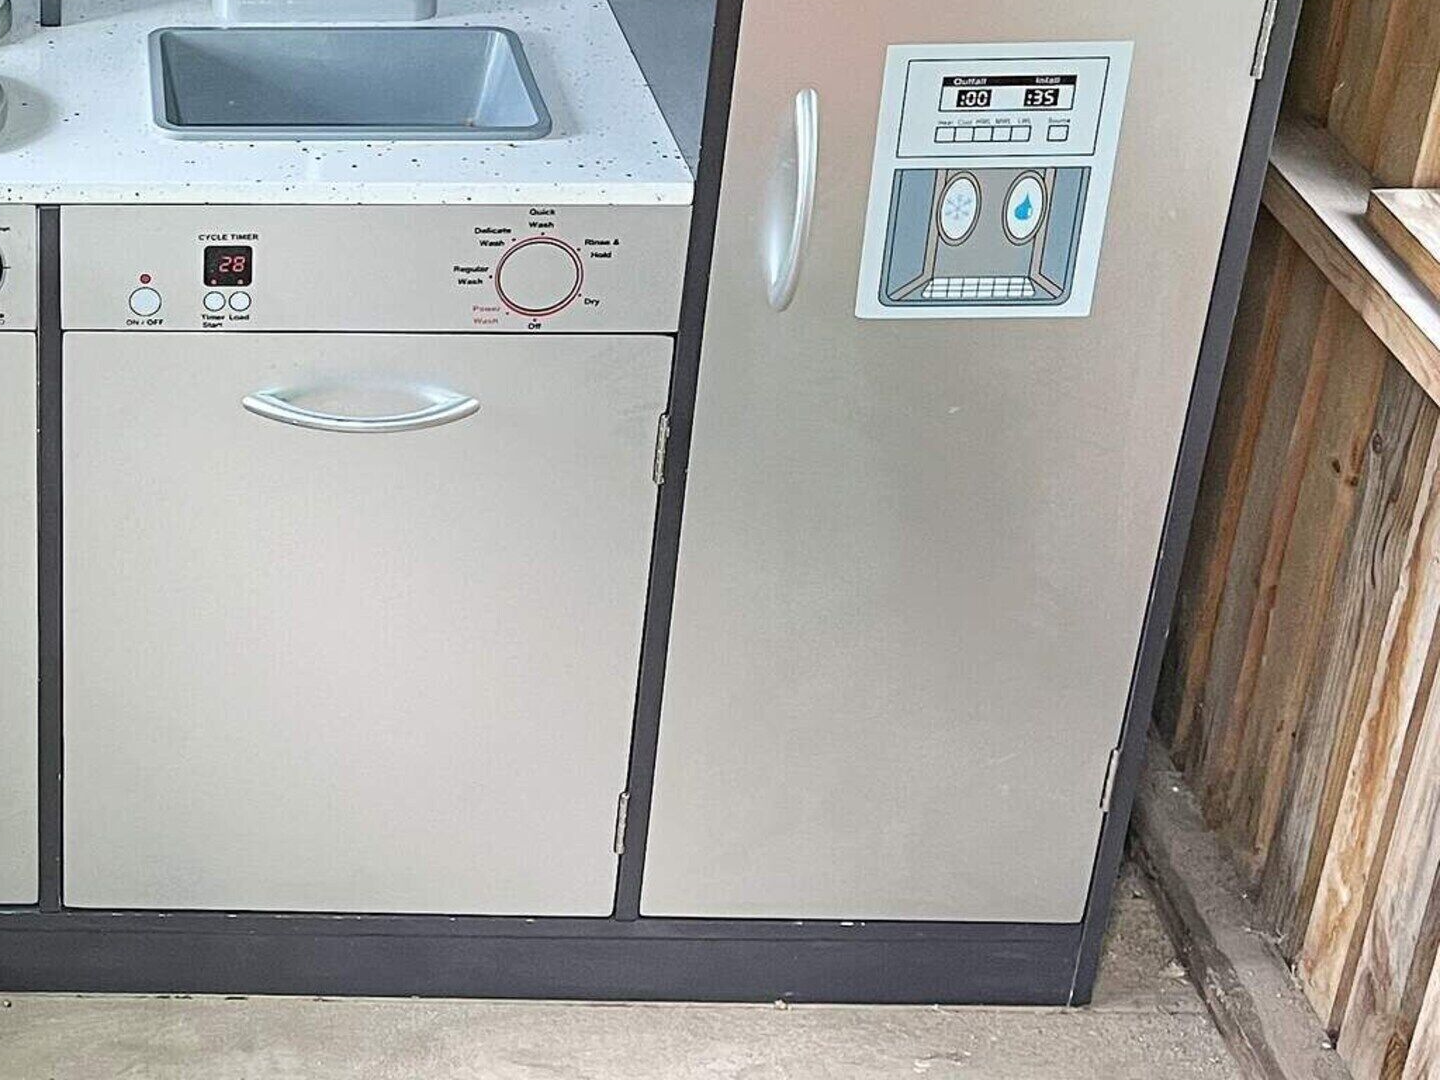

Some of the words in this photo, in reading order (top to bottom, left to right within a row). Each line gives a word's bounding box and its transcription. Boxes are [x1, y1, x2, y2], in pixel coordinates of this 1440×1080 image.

[231, 233, 260, 241] TIMER
[219, 256, 246, 272] 28
[584, 298, 600, 307] Dry
